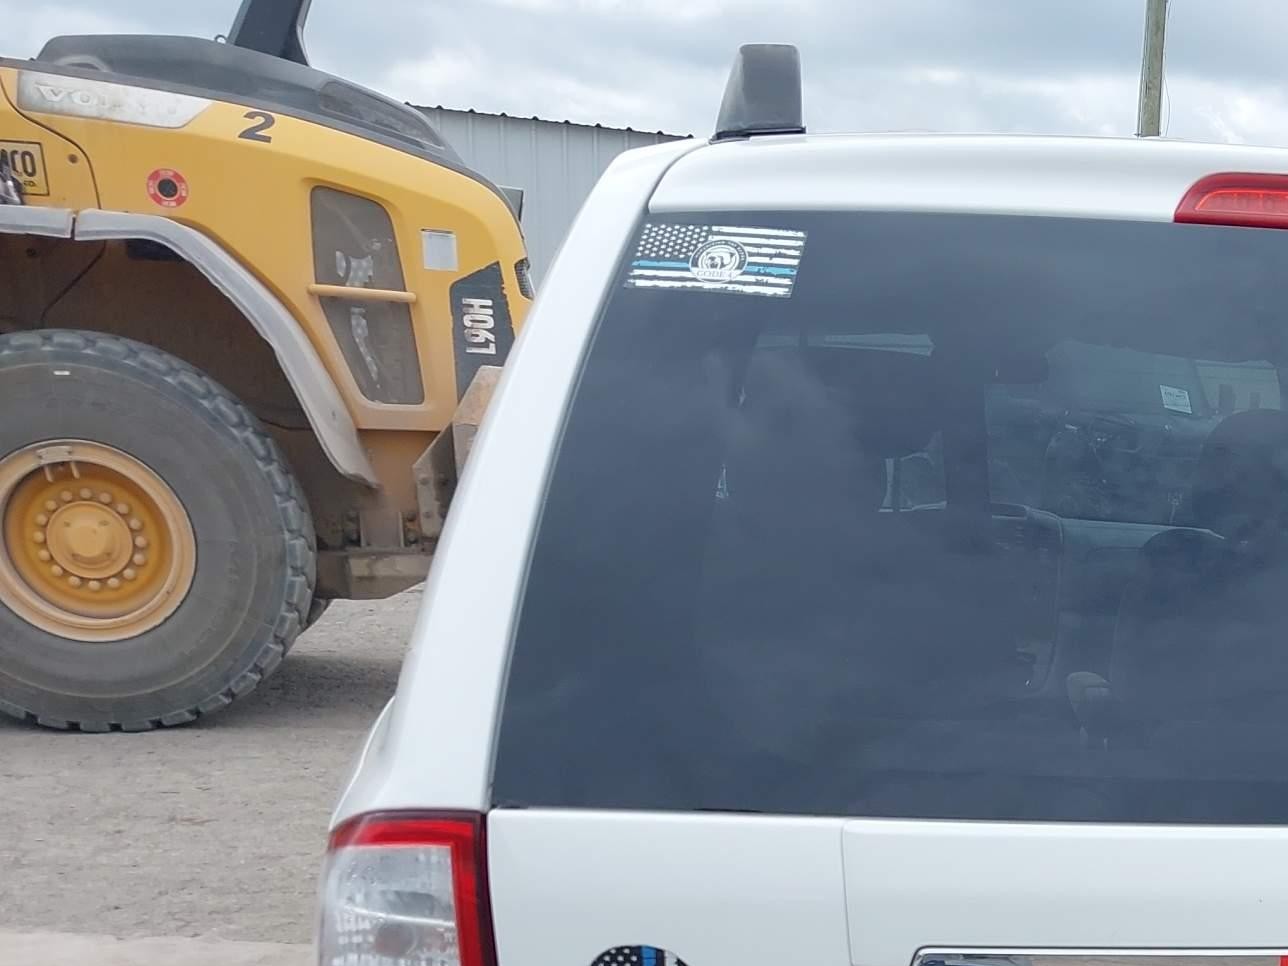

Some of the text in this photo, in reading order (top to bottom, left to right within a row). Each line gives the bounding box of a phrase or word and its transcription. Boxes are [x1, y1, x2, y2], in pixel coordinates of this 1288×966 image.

[35, 81, 180, 116] VOL
[238, 111, 276, 144] 2
[0, 149, 37, 177] CO
[462, 298, 497, 355] L90H
